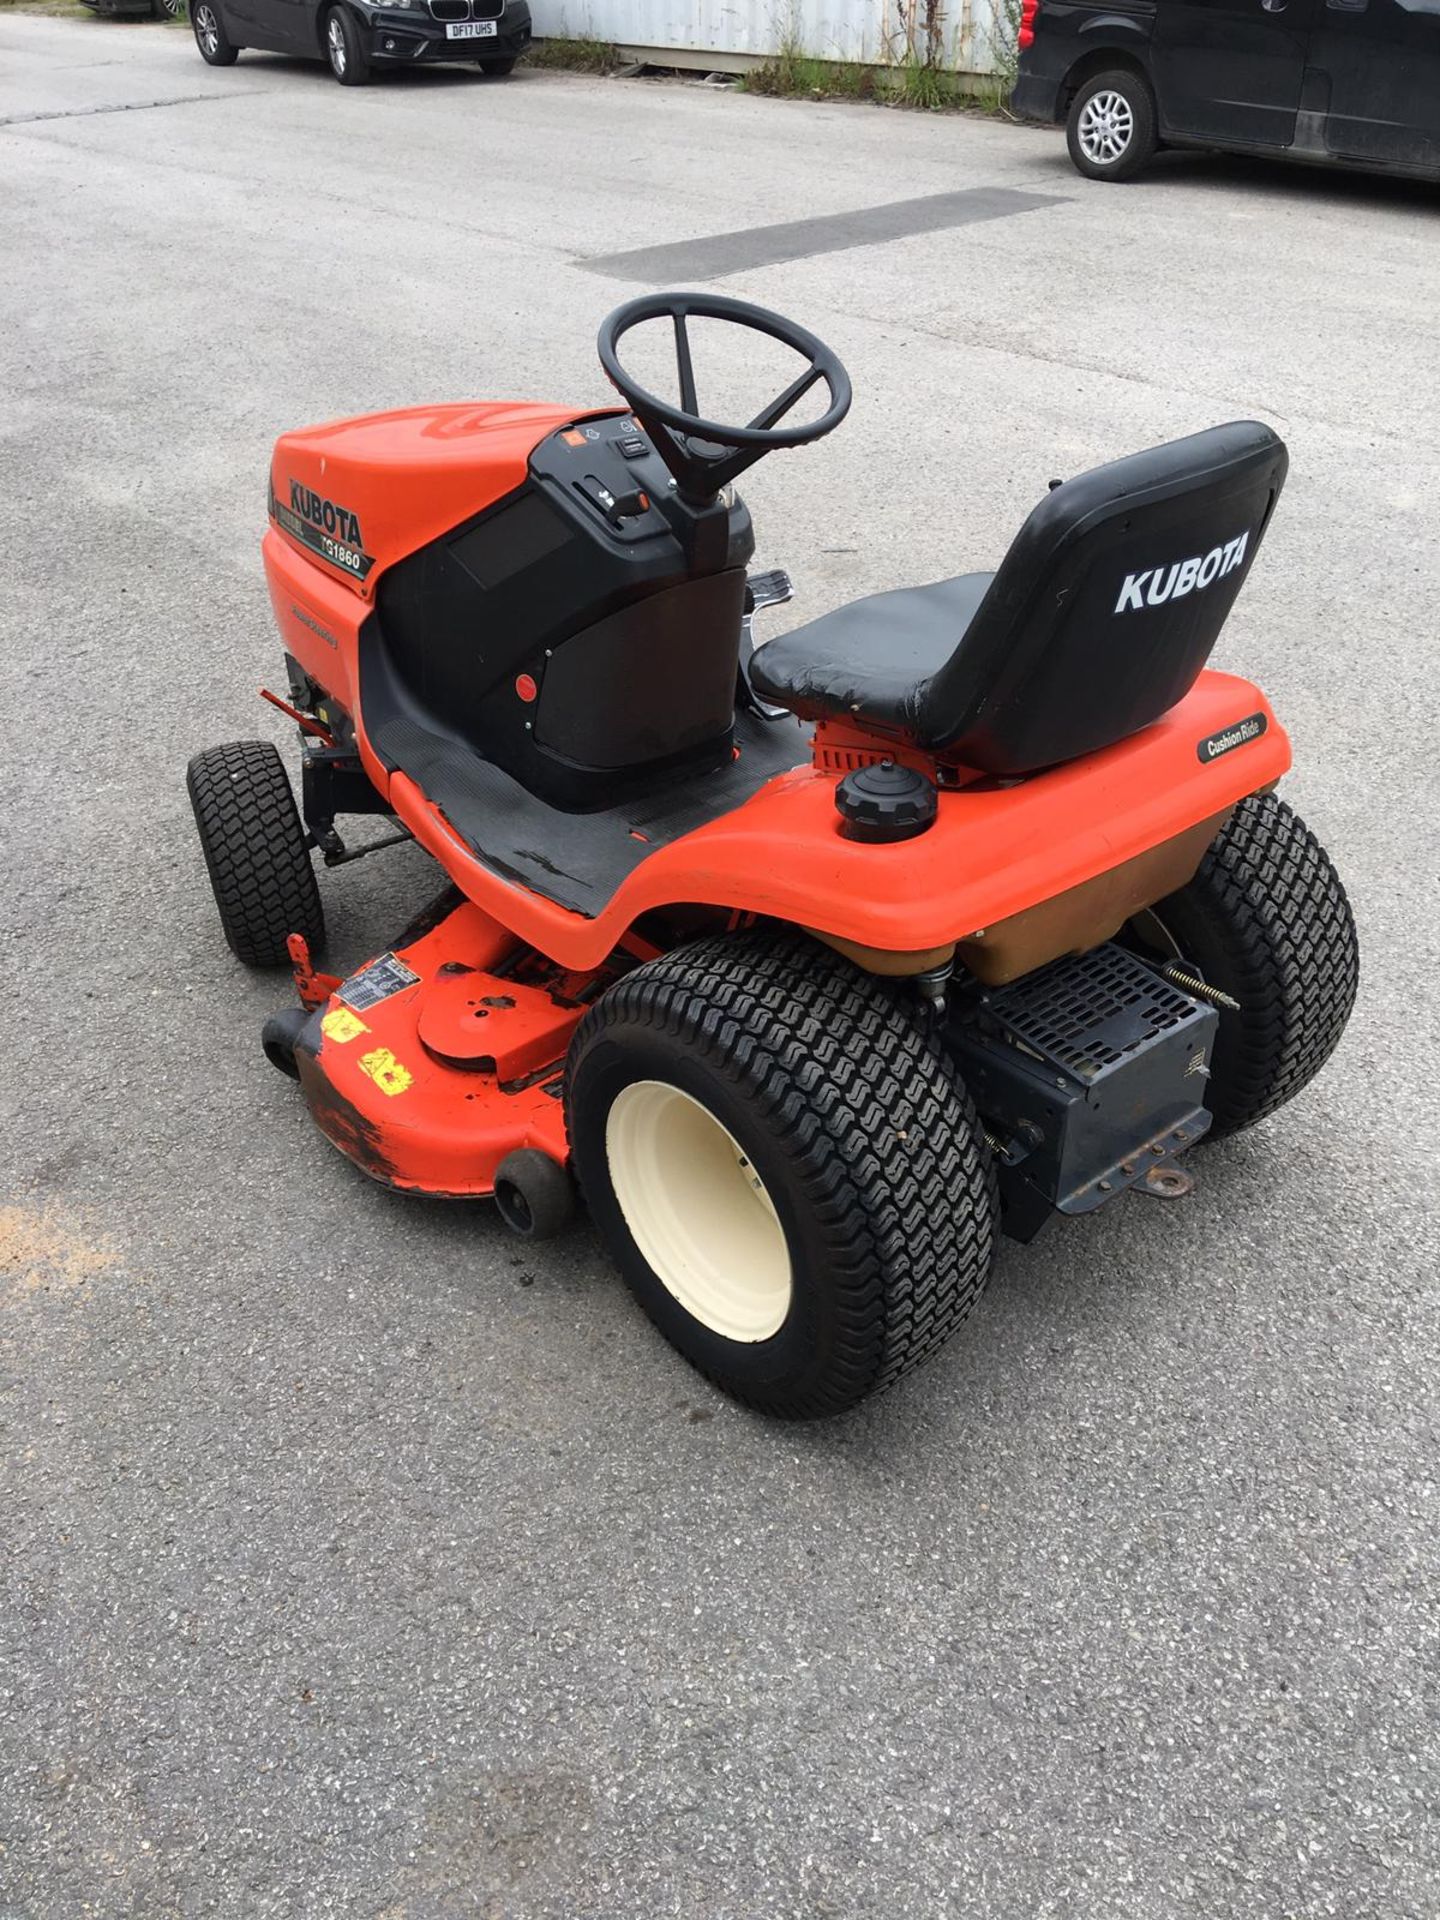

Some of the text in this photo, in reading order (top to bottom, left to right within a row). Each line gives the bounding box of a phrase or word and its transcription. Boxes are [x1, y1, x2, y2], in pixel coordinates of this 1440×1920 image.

[452, 22, 493, 37] DF17 UHS
[289, 478, 363, 549] KUBOTA
[1115, 531, 1249, 613] KUBOTA
[1207, 720, 1260, 757] Cushion Ride
